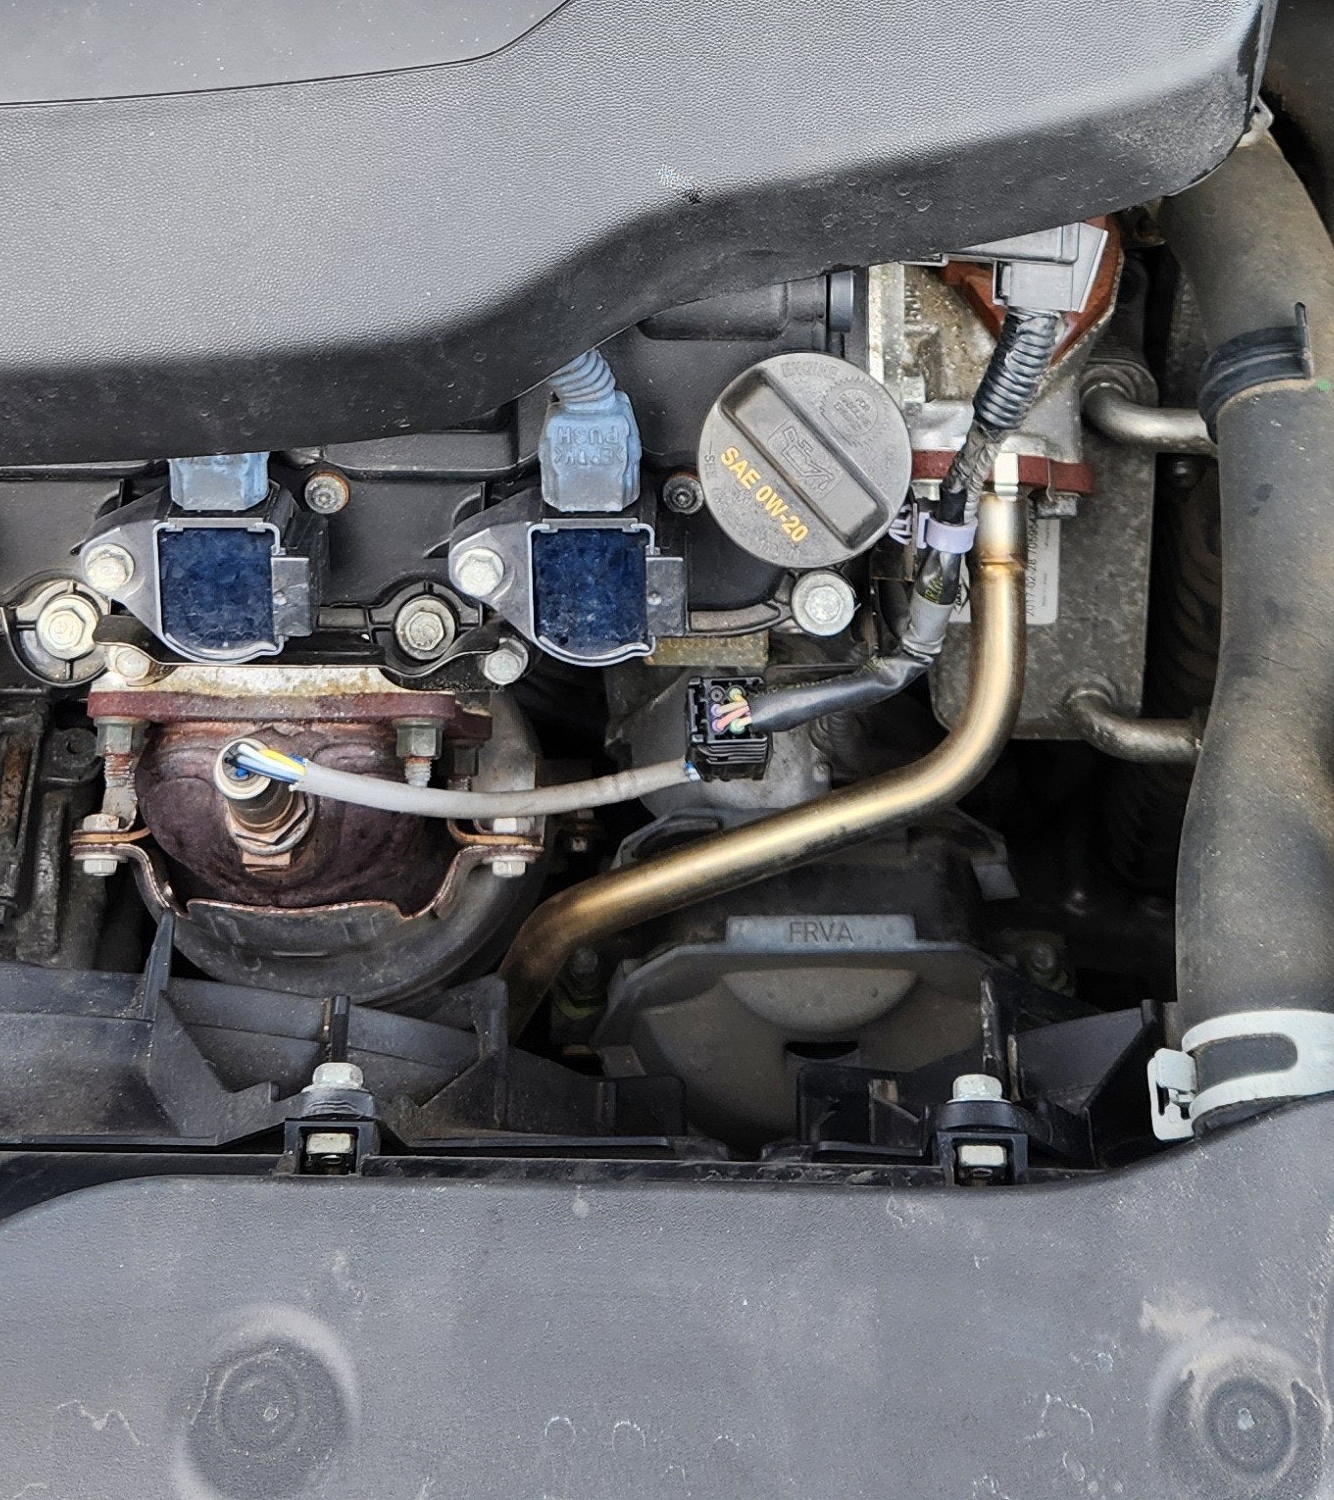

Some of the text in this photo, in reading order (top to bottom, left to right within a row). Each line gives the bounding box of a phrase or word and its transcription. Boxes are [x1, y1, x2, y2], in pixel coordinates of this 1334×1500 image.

[556, 425, 618, 445] PUSH
[719, 445, 761, 489] SAE
[753, 483, 809, 544] 0W-20
[787, 918, 856, 944] FRVA
